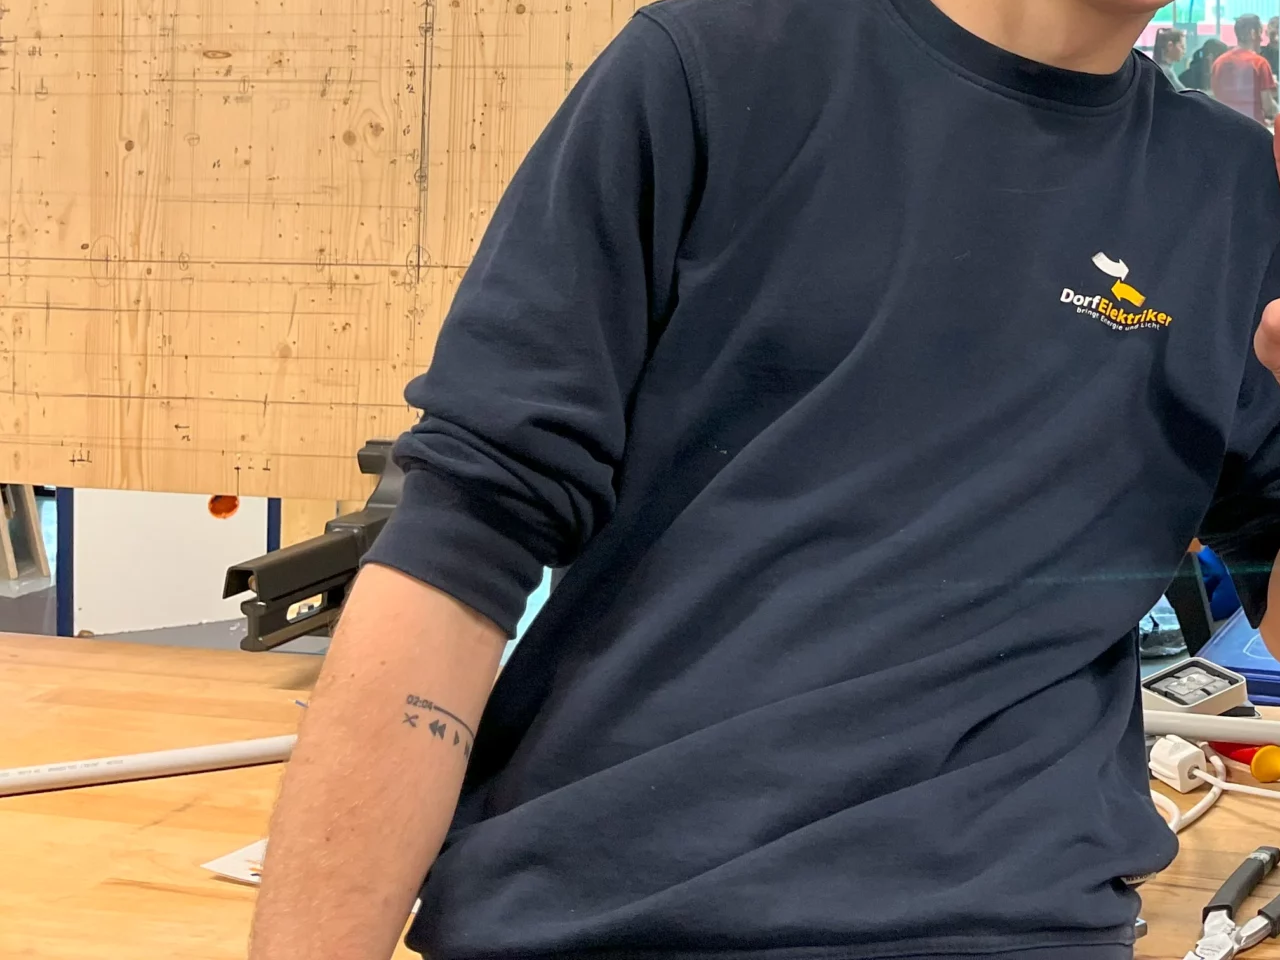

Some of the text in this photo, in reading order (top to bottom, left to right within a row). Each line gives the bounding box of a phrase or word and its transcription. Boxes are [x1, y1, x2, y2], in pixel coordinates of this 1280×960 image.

[1060, 288, 1172, 327] DorfElektriker
[1076, 307, 1100, 319] bringt
[1100, 315, 1123, 331] Energie
